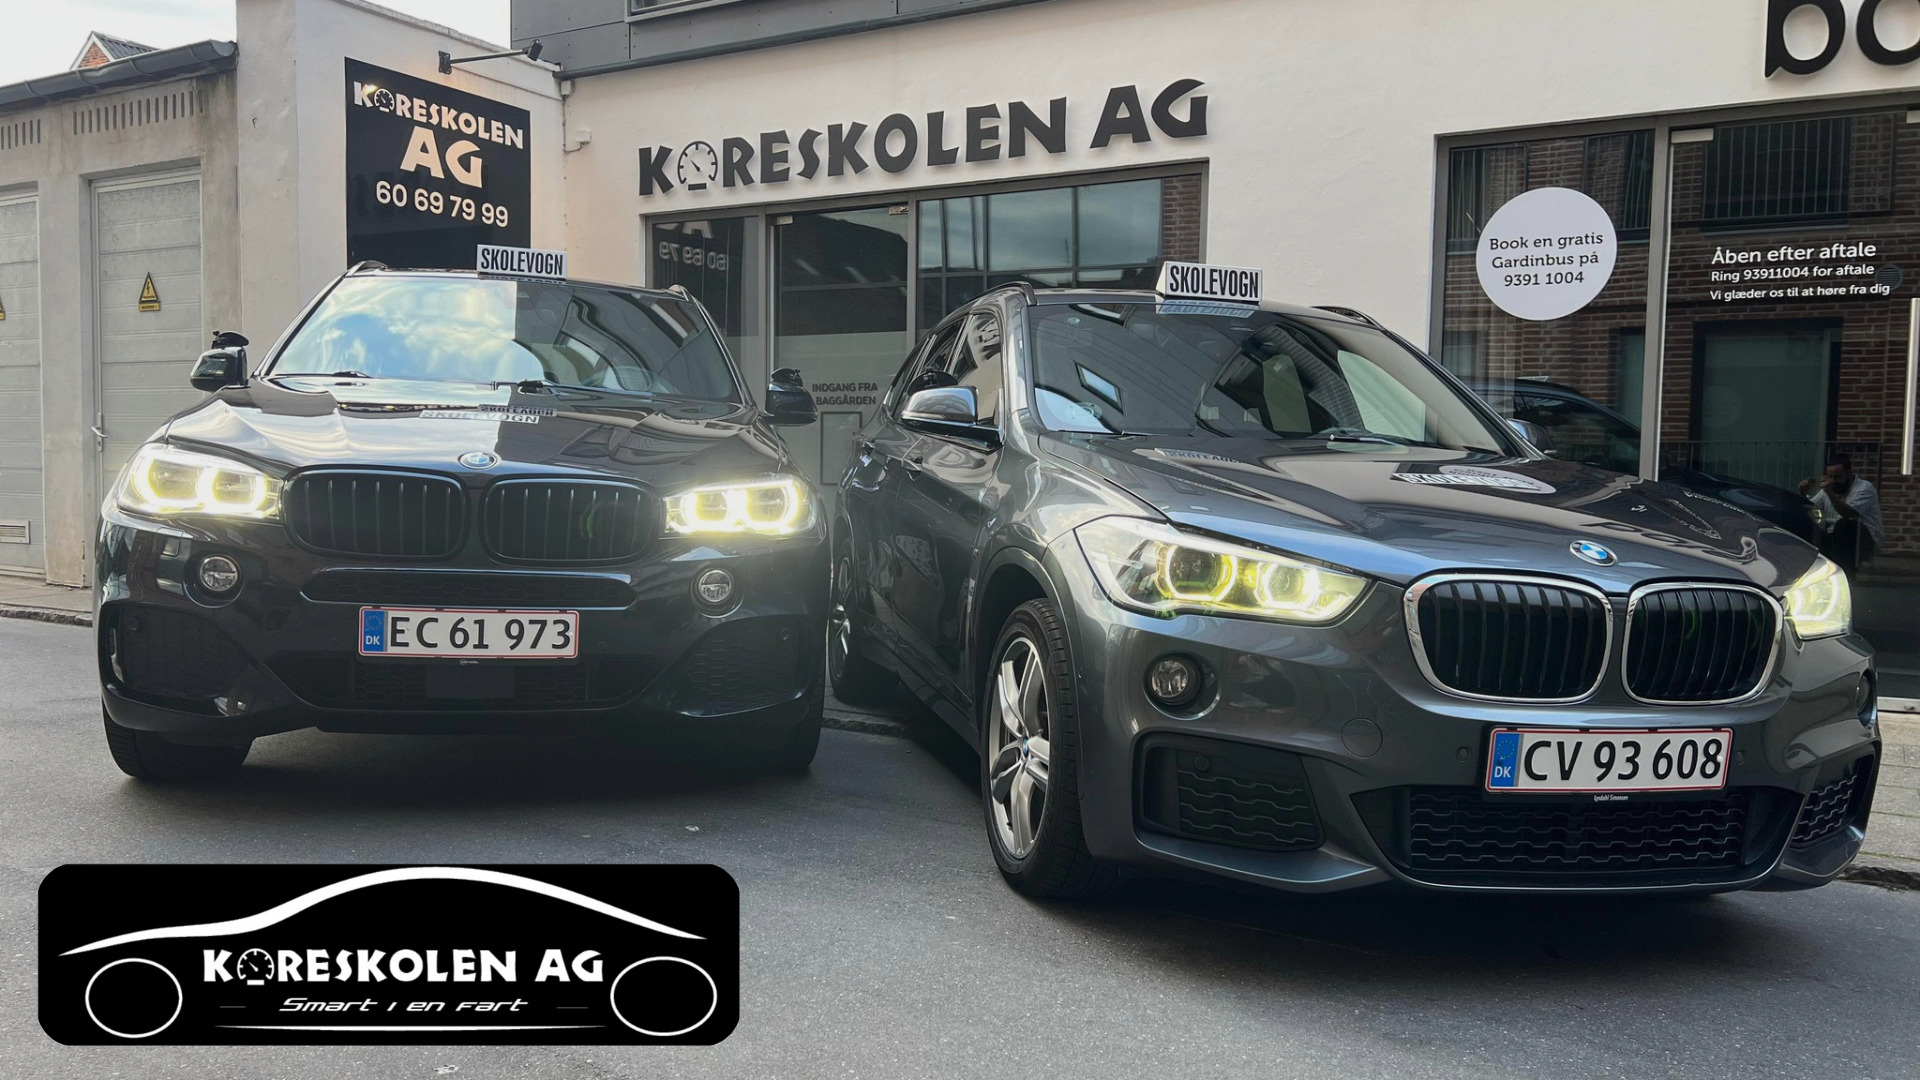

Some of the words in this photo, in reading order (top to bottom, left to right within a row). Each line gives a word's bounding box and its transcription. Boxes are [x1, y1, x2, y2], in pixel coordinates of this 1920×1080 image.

[1090, 78, 1208, 149] AG
[400, 125, 483, 188] AG
[376, 180, 407, 207] 60
[414, 188, 444, 215] 69
[450, 195, 476, 221] 79
[481, 202, 509, 228] 99
[1489, 237, 1529, 250] Book
[1533, 238, 1553, 248] en
[1557, 232, 1603, 249] gratis
[480, 248, 563, 276] SKOLEVOGN
[1491, 253, 1574, 269] Gardinbus
[1579, 251, 1599, 267] på
[1711, 246, 1762, 265] Åben
[1767, 245, 1815, 262] efter
[1819, 242, 1877, 260] aftale
[1169, 265, 1259, 298] SKOLEVOGN
[1504, 273, 1540, 287] 9391
[1545, 271, 1584, 285] 1004
[1711, 271, 1740, 283] Ring
[1743, 266, 1809, 281] 93911004
[1812, 265, 1833, 277] for
[1835, 264, 1875, 276] aftale
[1710, 290, 1722, 300] Vi
[1724, 289, 1767, 301] glæder
[1769, 288, 1784, 297] os
[1787, 286, 1799, 297] til
[1801, 286, 1814, 296] at
[1817, 283, 1847, 296] høre
[1850, 284, 1867, 294] fra
[1869, 283, 1890, 296] dig
[812, 383, 856, 392] INDGANG
[858, 382, 878, 391] FRA
[816, 394, 876, 405] BAGGÅRDEN
[365, 635, 380, 646] DK
[390, 616, 439, 648] EC
[449, 617, 489, 650] 61
[504, 618, 571, 651] 973
[1523, 740, 1583, 781] CV
[1593, 740, 1642, 783] 93
[1652, 738, 1723, 780] 608
[1494, 766, 1511, 778] DK
